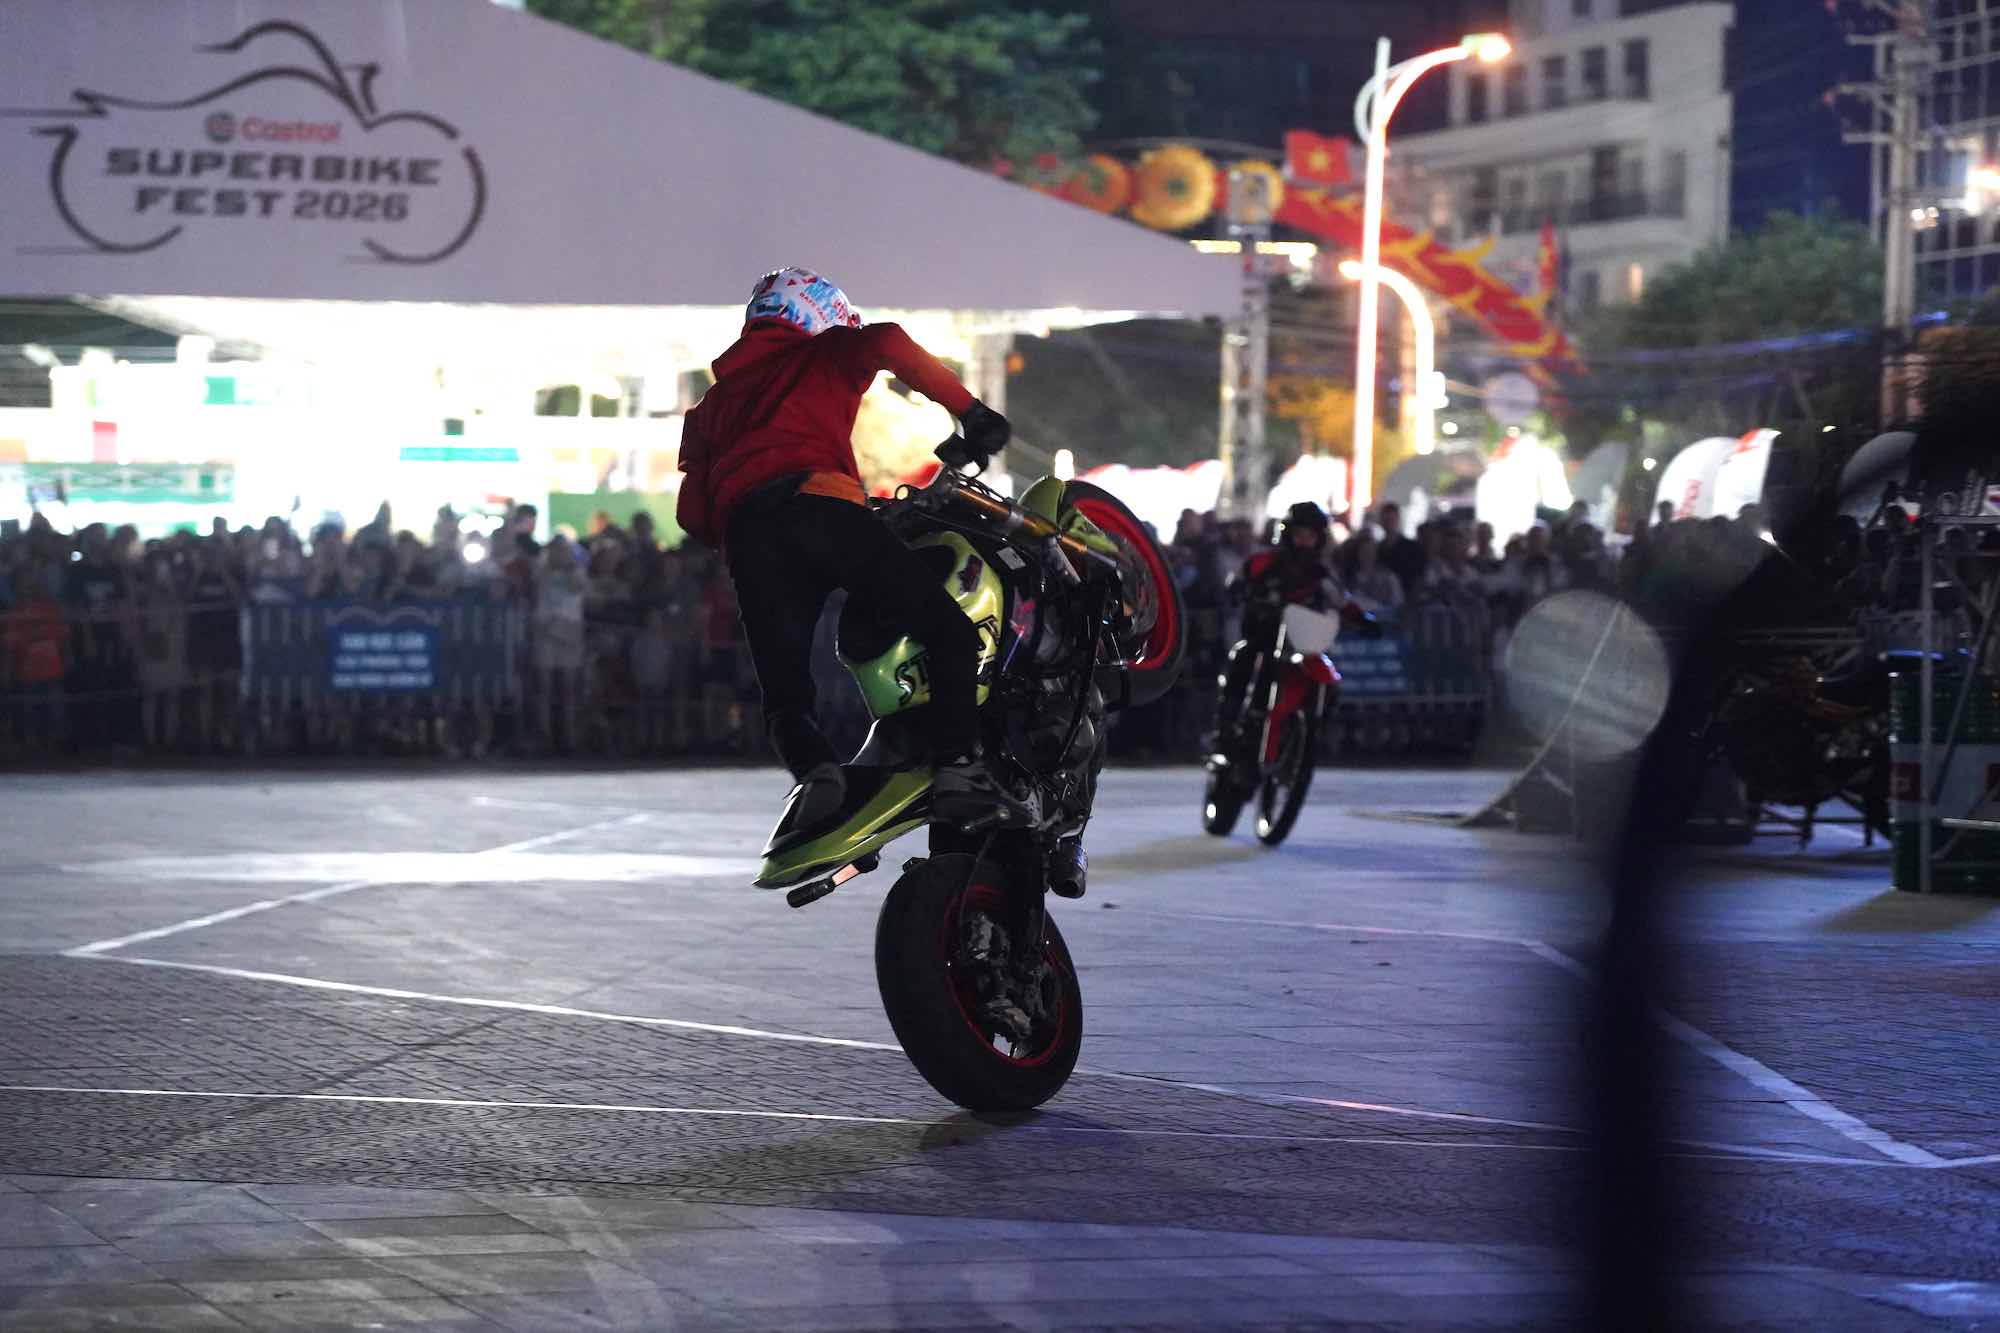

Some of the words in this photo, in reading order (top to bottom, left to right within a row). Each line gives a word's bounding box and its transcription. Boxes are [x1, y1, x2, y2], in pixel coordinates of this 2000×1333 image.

[240, 115, 340, 142] Castrol
[105, 147, 442, 185] SUPERBIKE
[133, 186, 284, 217] FEST
[292, 189, 409, 222] 2026
